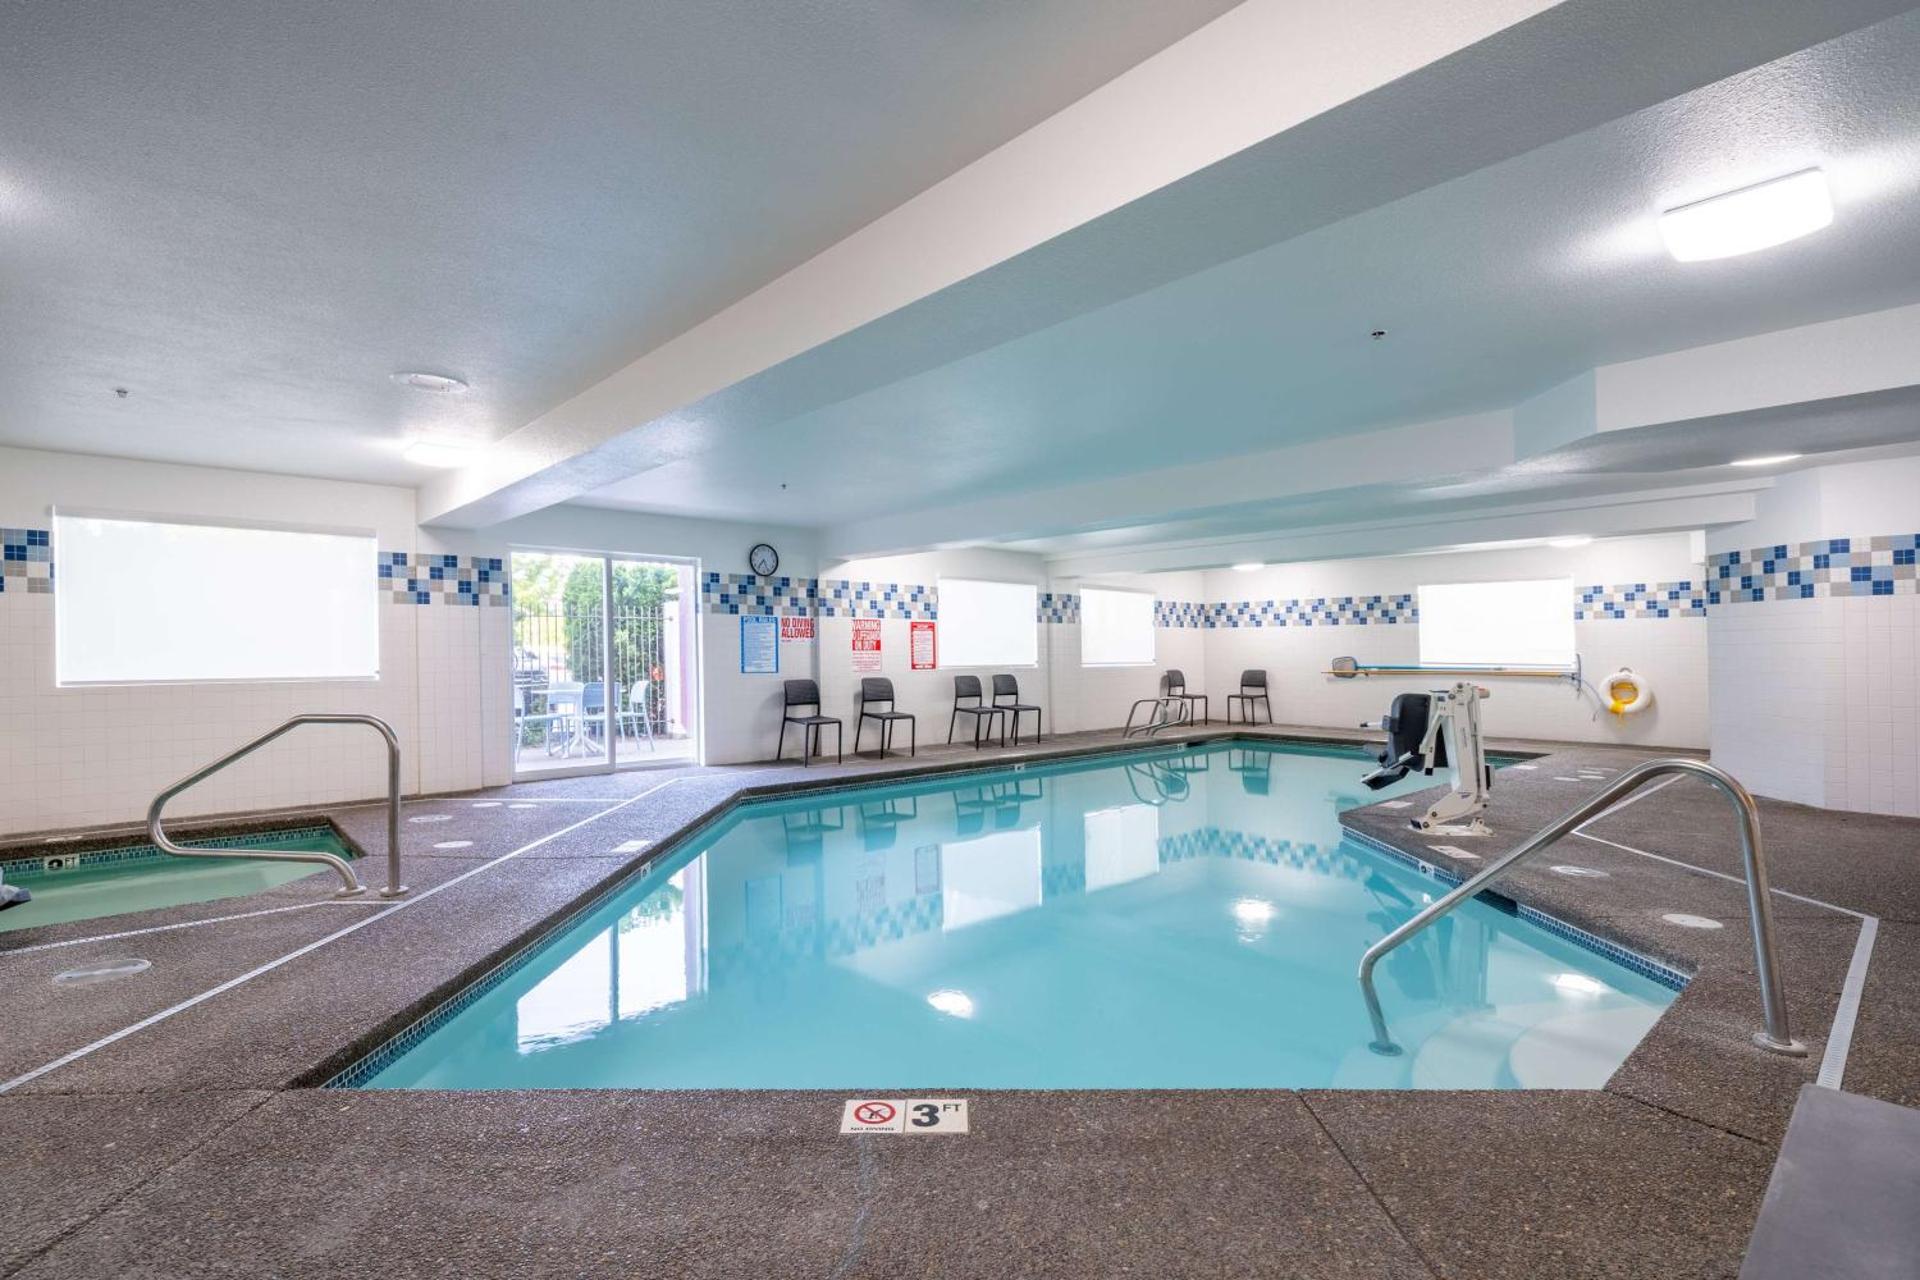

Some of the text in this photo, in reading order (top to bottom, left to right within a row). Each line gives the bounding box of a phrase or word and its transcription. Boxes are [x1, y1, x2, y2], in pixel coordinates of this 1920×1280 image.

[781, 618, 814, 628] NO DIVING
[782, 628, 815, 638] ALLOWED
[911, 1103, 961, 1127] 3 FT
